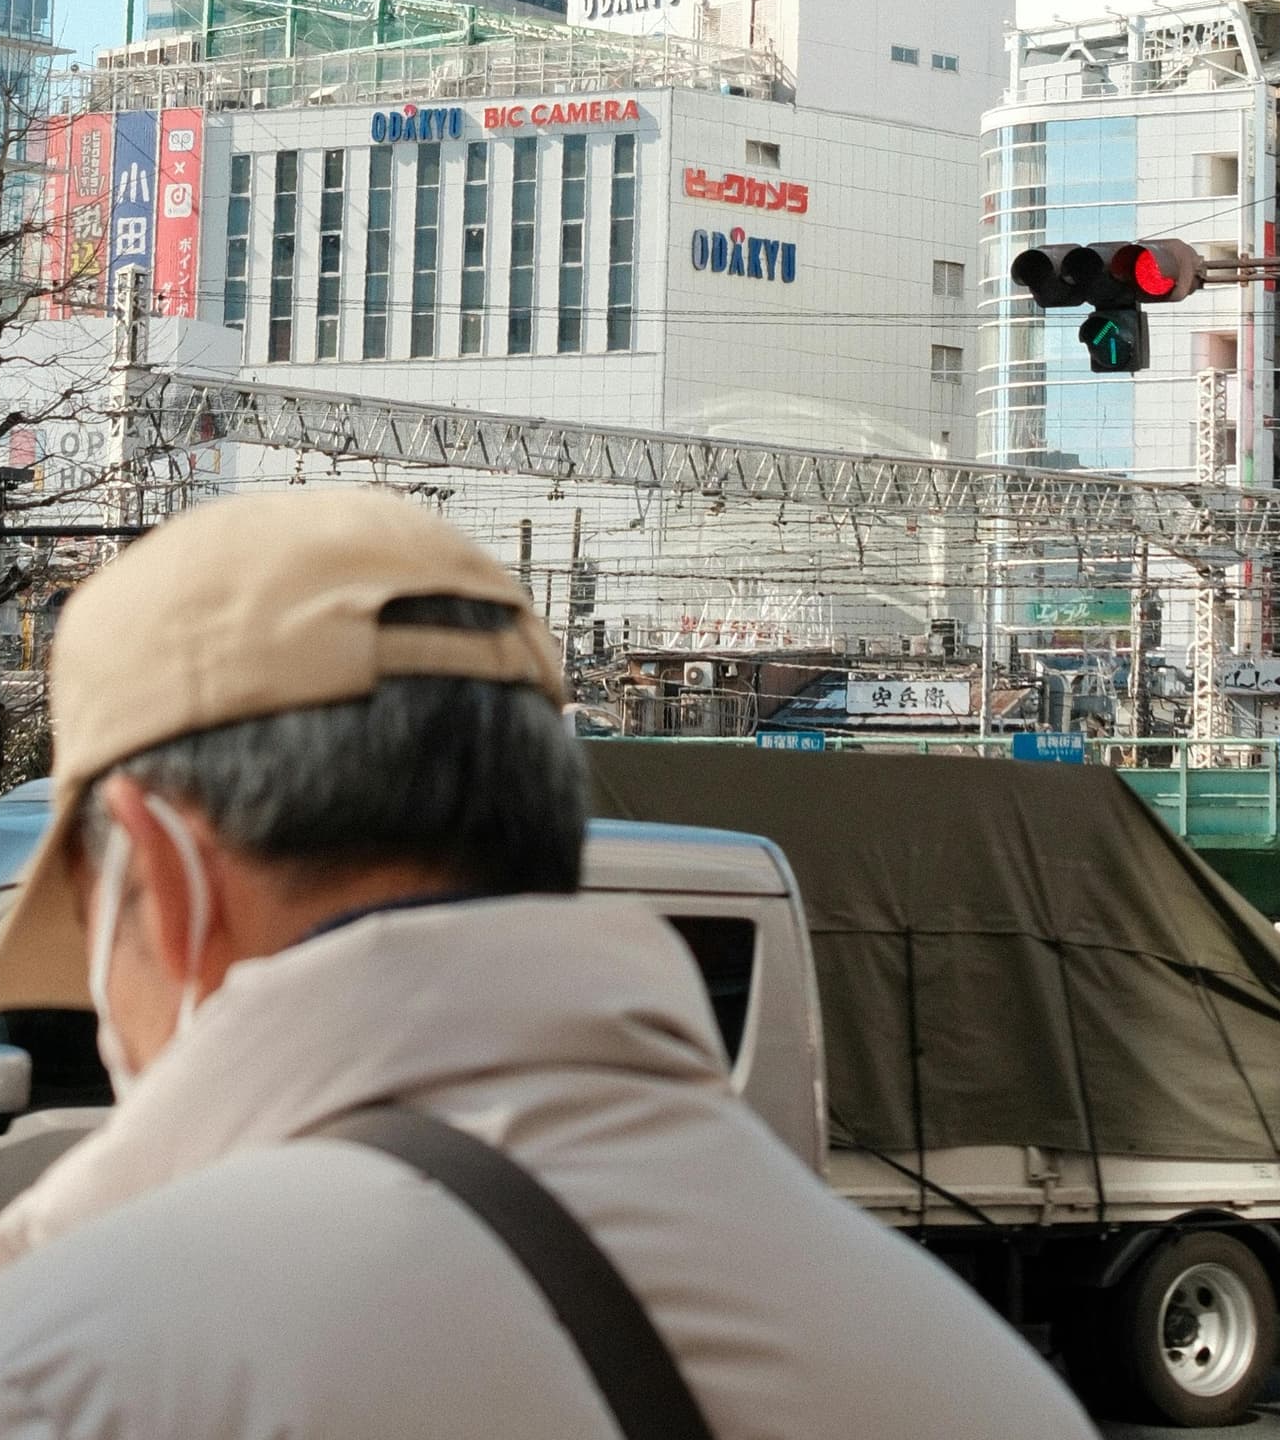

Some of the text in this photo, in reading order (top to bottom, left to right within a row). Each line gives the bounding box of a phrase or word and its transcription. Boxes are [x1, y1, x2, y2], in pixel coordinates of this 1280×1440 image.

[371, 98, 640, 143] ODAKYU BIC CAMERA
[116, 161, 150, 257] 小田
[684, 166, 809, 214] ビックカメラ
[692, 226, 797, 284] ODAKYU
